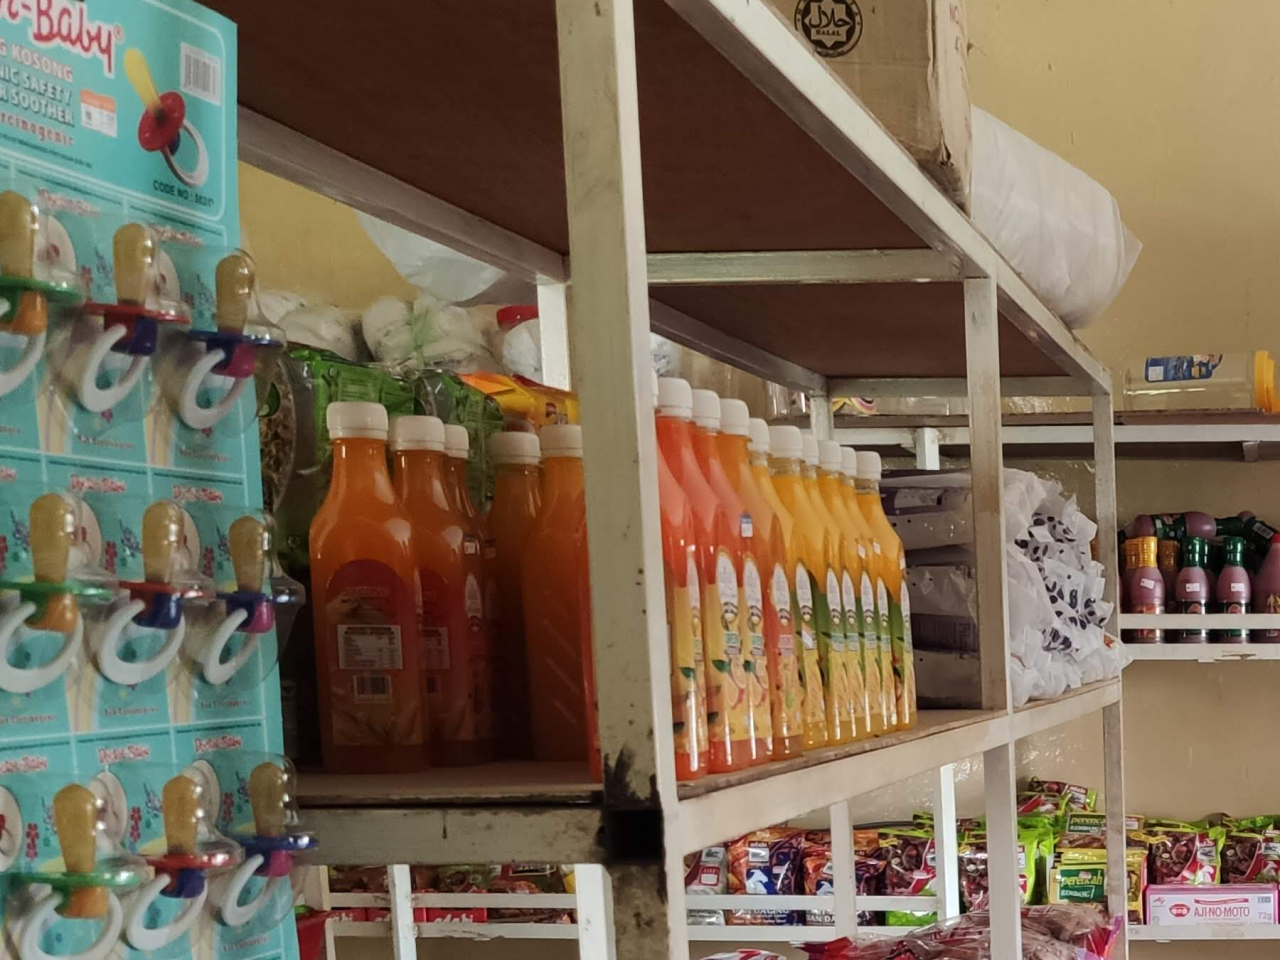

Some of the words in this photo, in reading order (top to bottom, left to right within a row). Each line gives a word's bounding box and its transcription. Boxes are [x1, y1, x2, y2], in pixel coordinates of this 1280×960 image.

[815, 29, 842, 37] HALAL
[11, 42, 74, 83] KOSONG
[22, 72, 73, 106] SAFETY
[11, 87, 75, 128] SOOTHER
[1258, 911, 1272, 920] 72g
